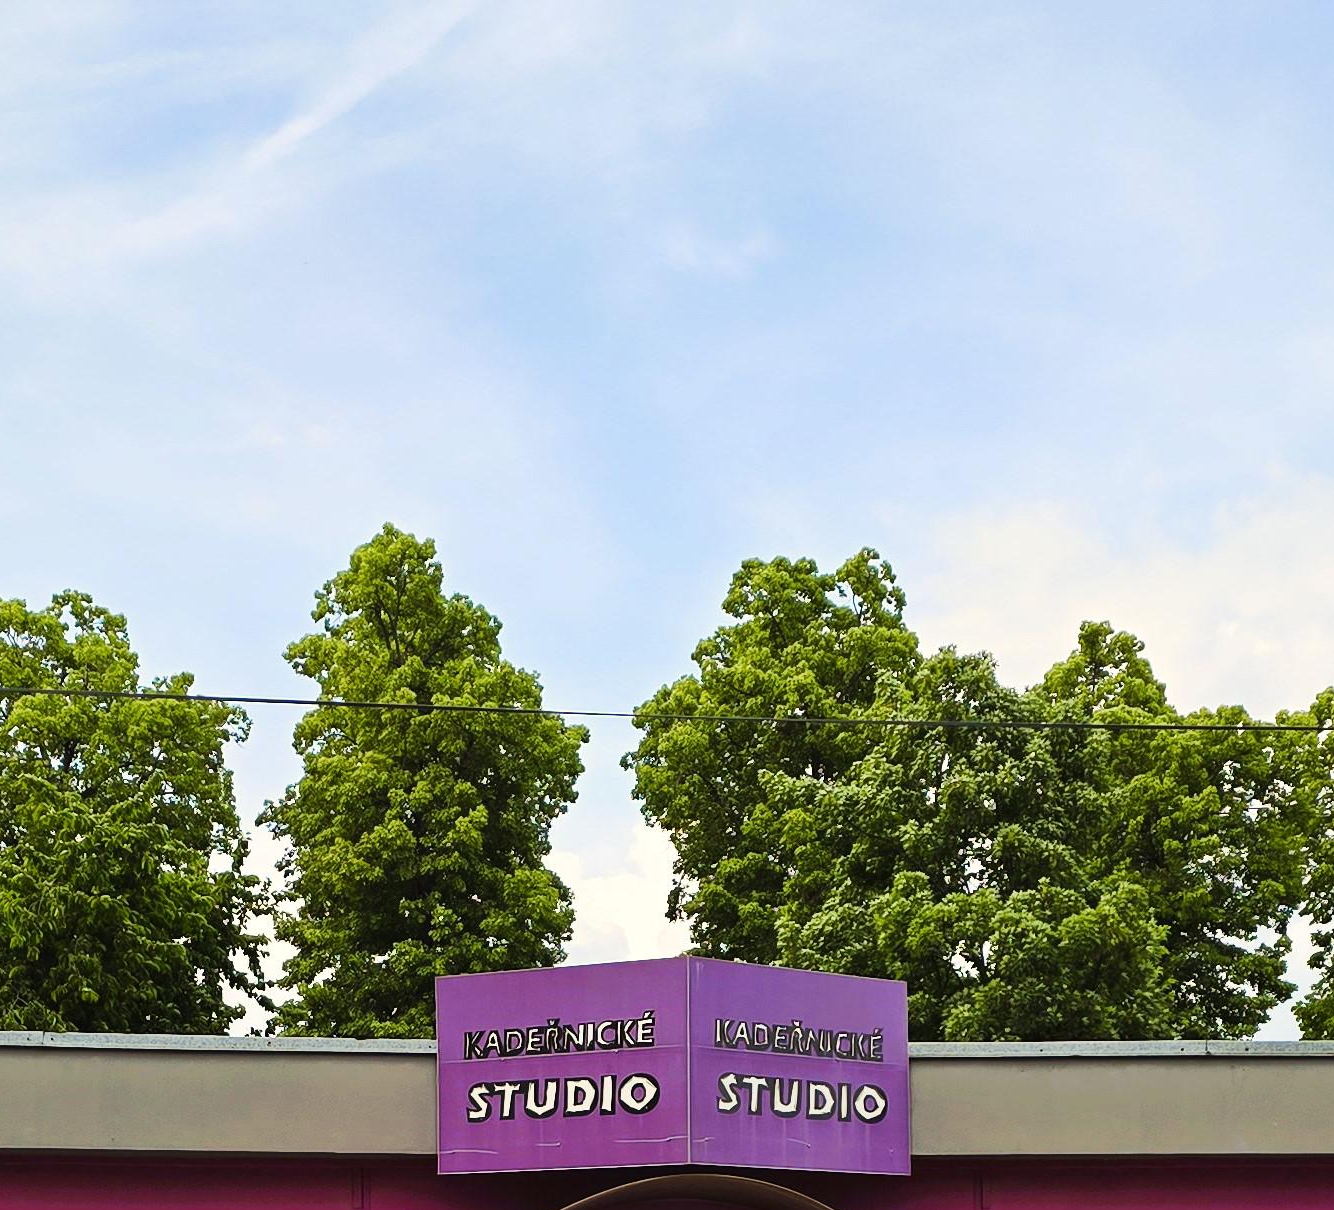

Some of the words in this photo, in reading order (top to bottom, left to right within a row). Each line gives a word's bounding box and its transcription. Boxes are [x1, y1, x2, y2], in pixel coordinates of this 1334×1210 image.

[464, 1010, 655, 1059] KADEŘNICKÉ
[716, 1020, 883, 1061] KADEŘNICKÉ
[467, 1072, 660, 1123] STUDIO
[718, 1072, 888, 1124] STUDIO
